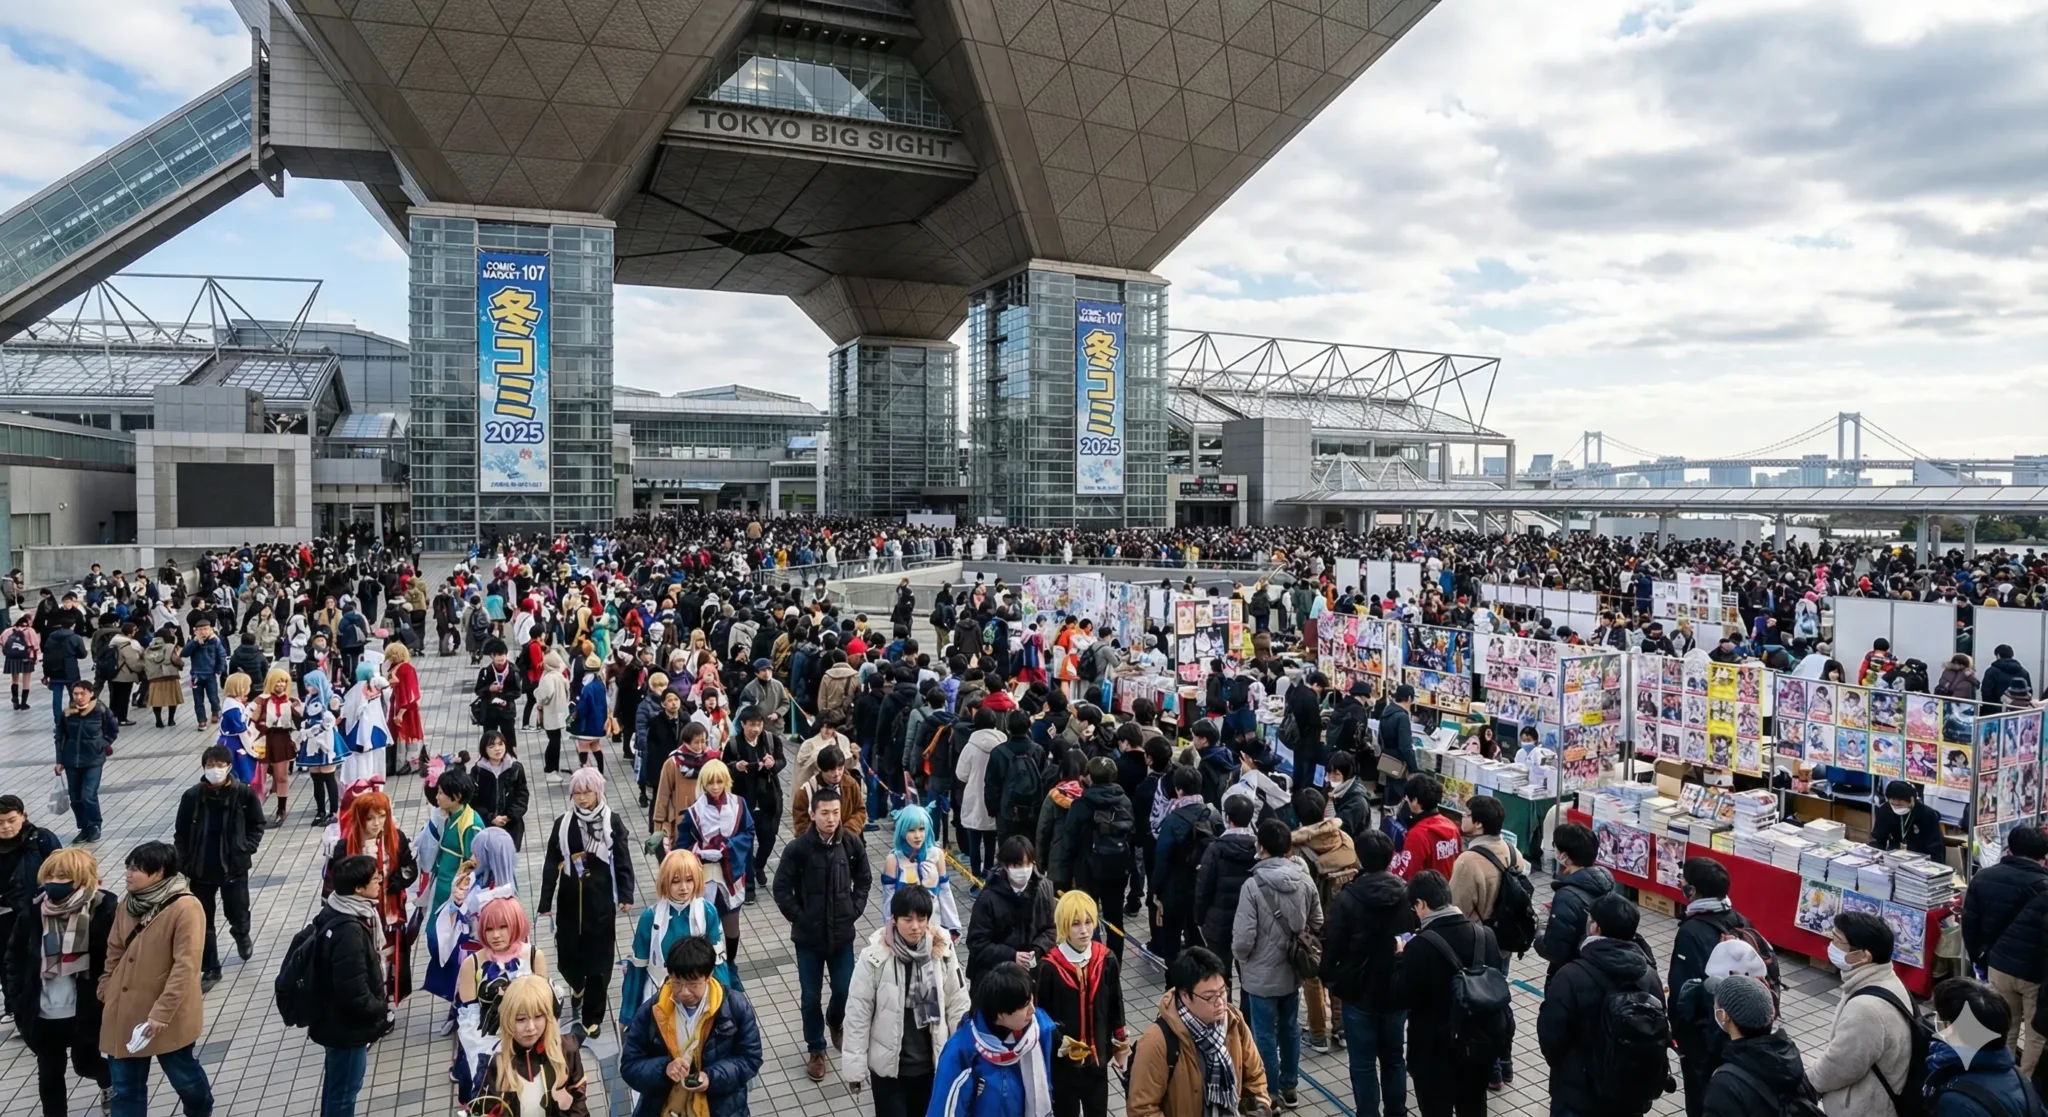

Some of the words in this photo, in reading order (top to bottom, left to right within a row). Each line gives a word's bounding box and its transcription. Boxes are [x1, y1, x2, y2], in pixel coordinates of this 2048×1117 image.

[698, 109, 801, 139] TOKYO
[811, 123, 860, 147] BIG
[867, 130, 953, 158] SIGHT
[482, 269, 520, 280] MARKET
[486, 261, 516, 271] COMIC
[521, 264, 546, 281] 107
[1106, 311, 1122, 325] 107
[487, 286, 544, 421] 冬コミ
[1081, 328, 1121, 437] 冬コミ
[485, 421, 544, 444] 2025
[1080, 437, 1121, 455] 2025
